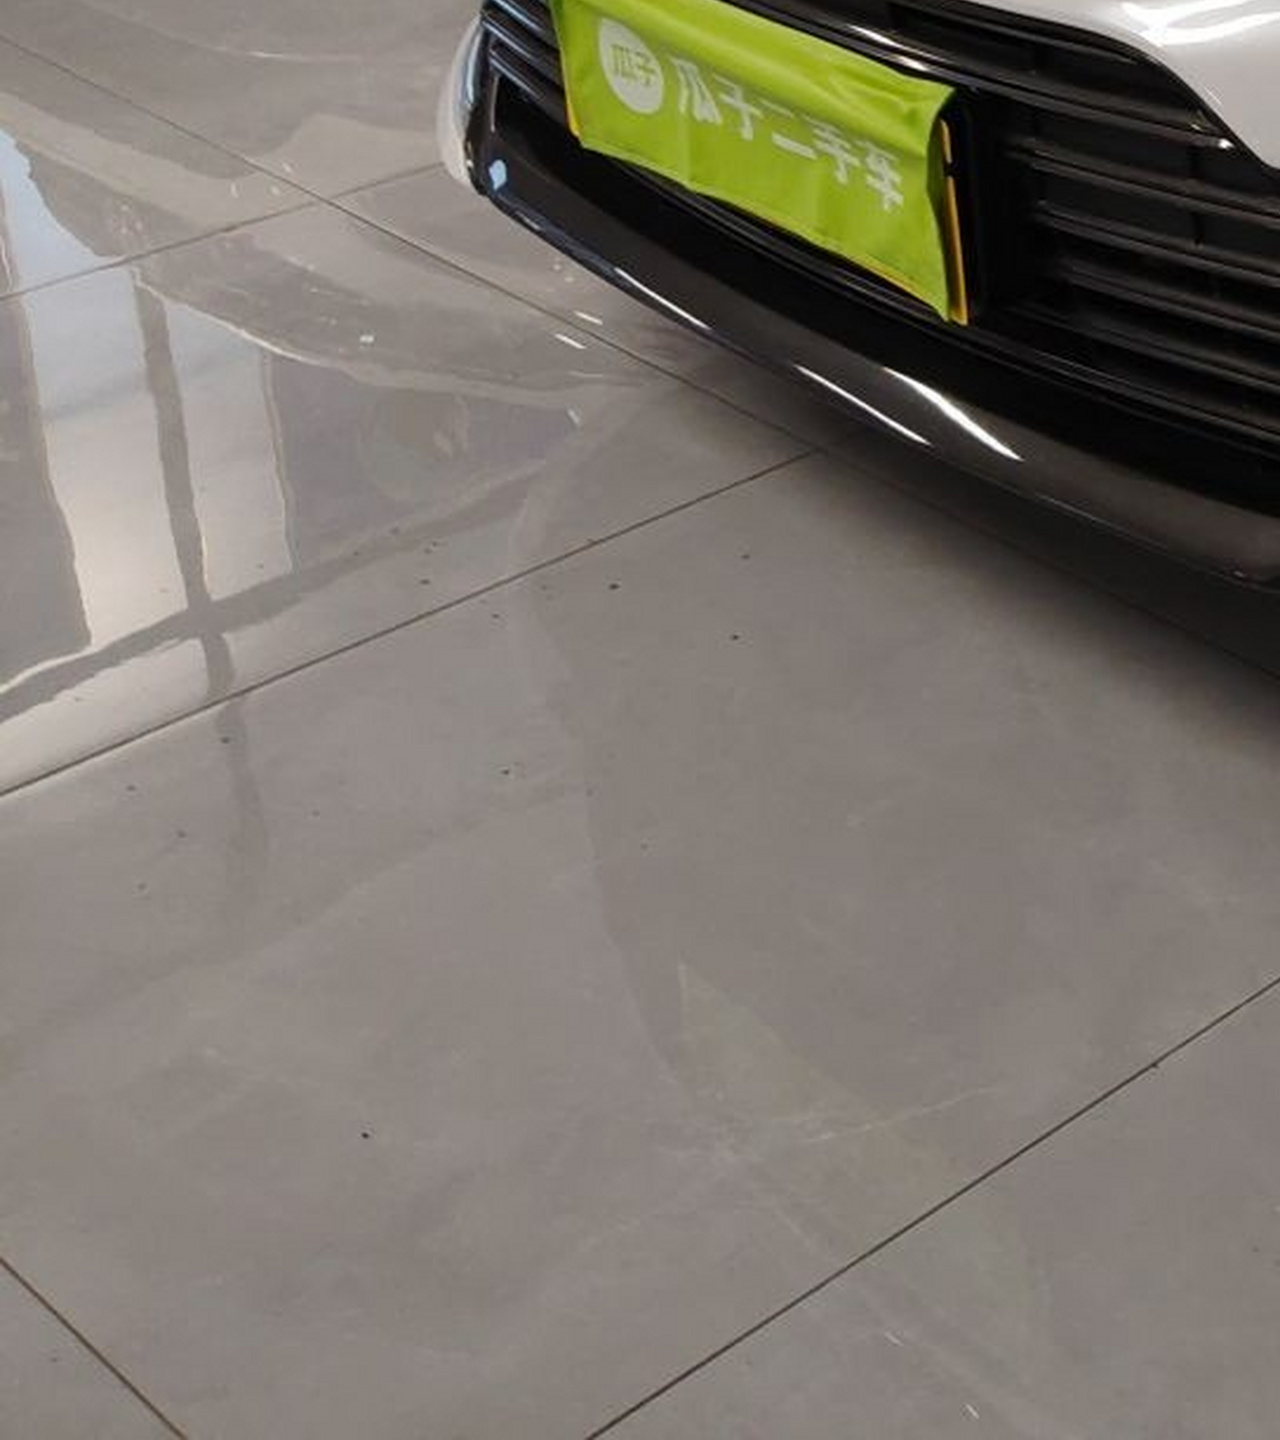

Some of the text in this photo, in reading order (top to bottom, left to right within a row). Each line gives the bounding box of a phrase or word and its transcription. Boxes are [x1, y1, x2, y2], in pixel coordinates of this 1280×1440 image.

[669, 56, 904, 212] 瓜子二手车
